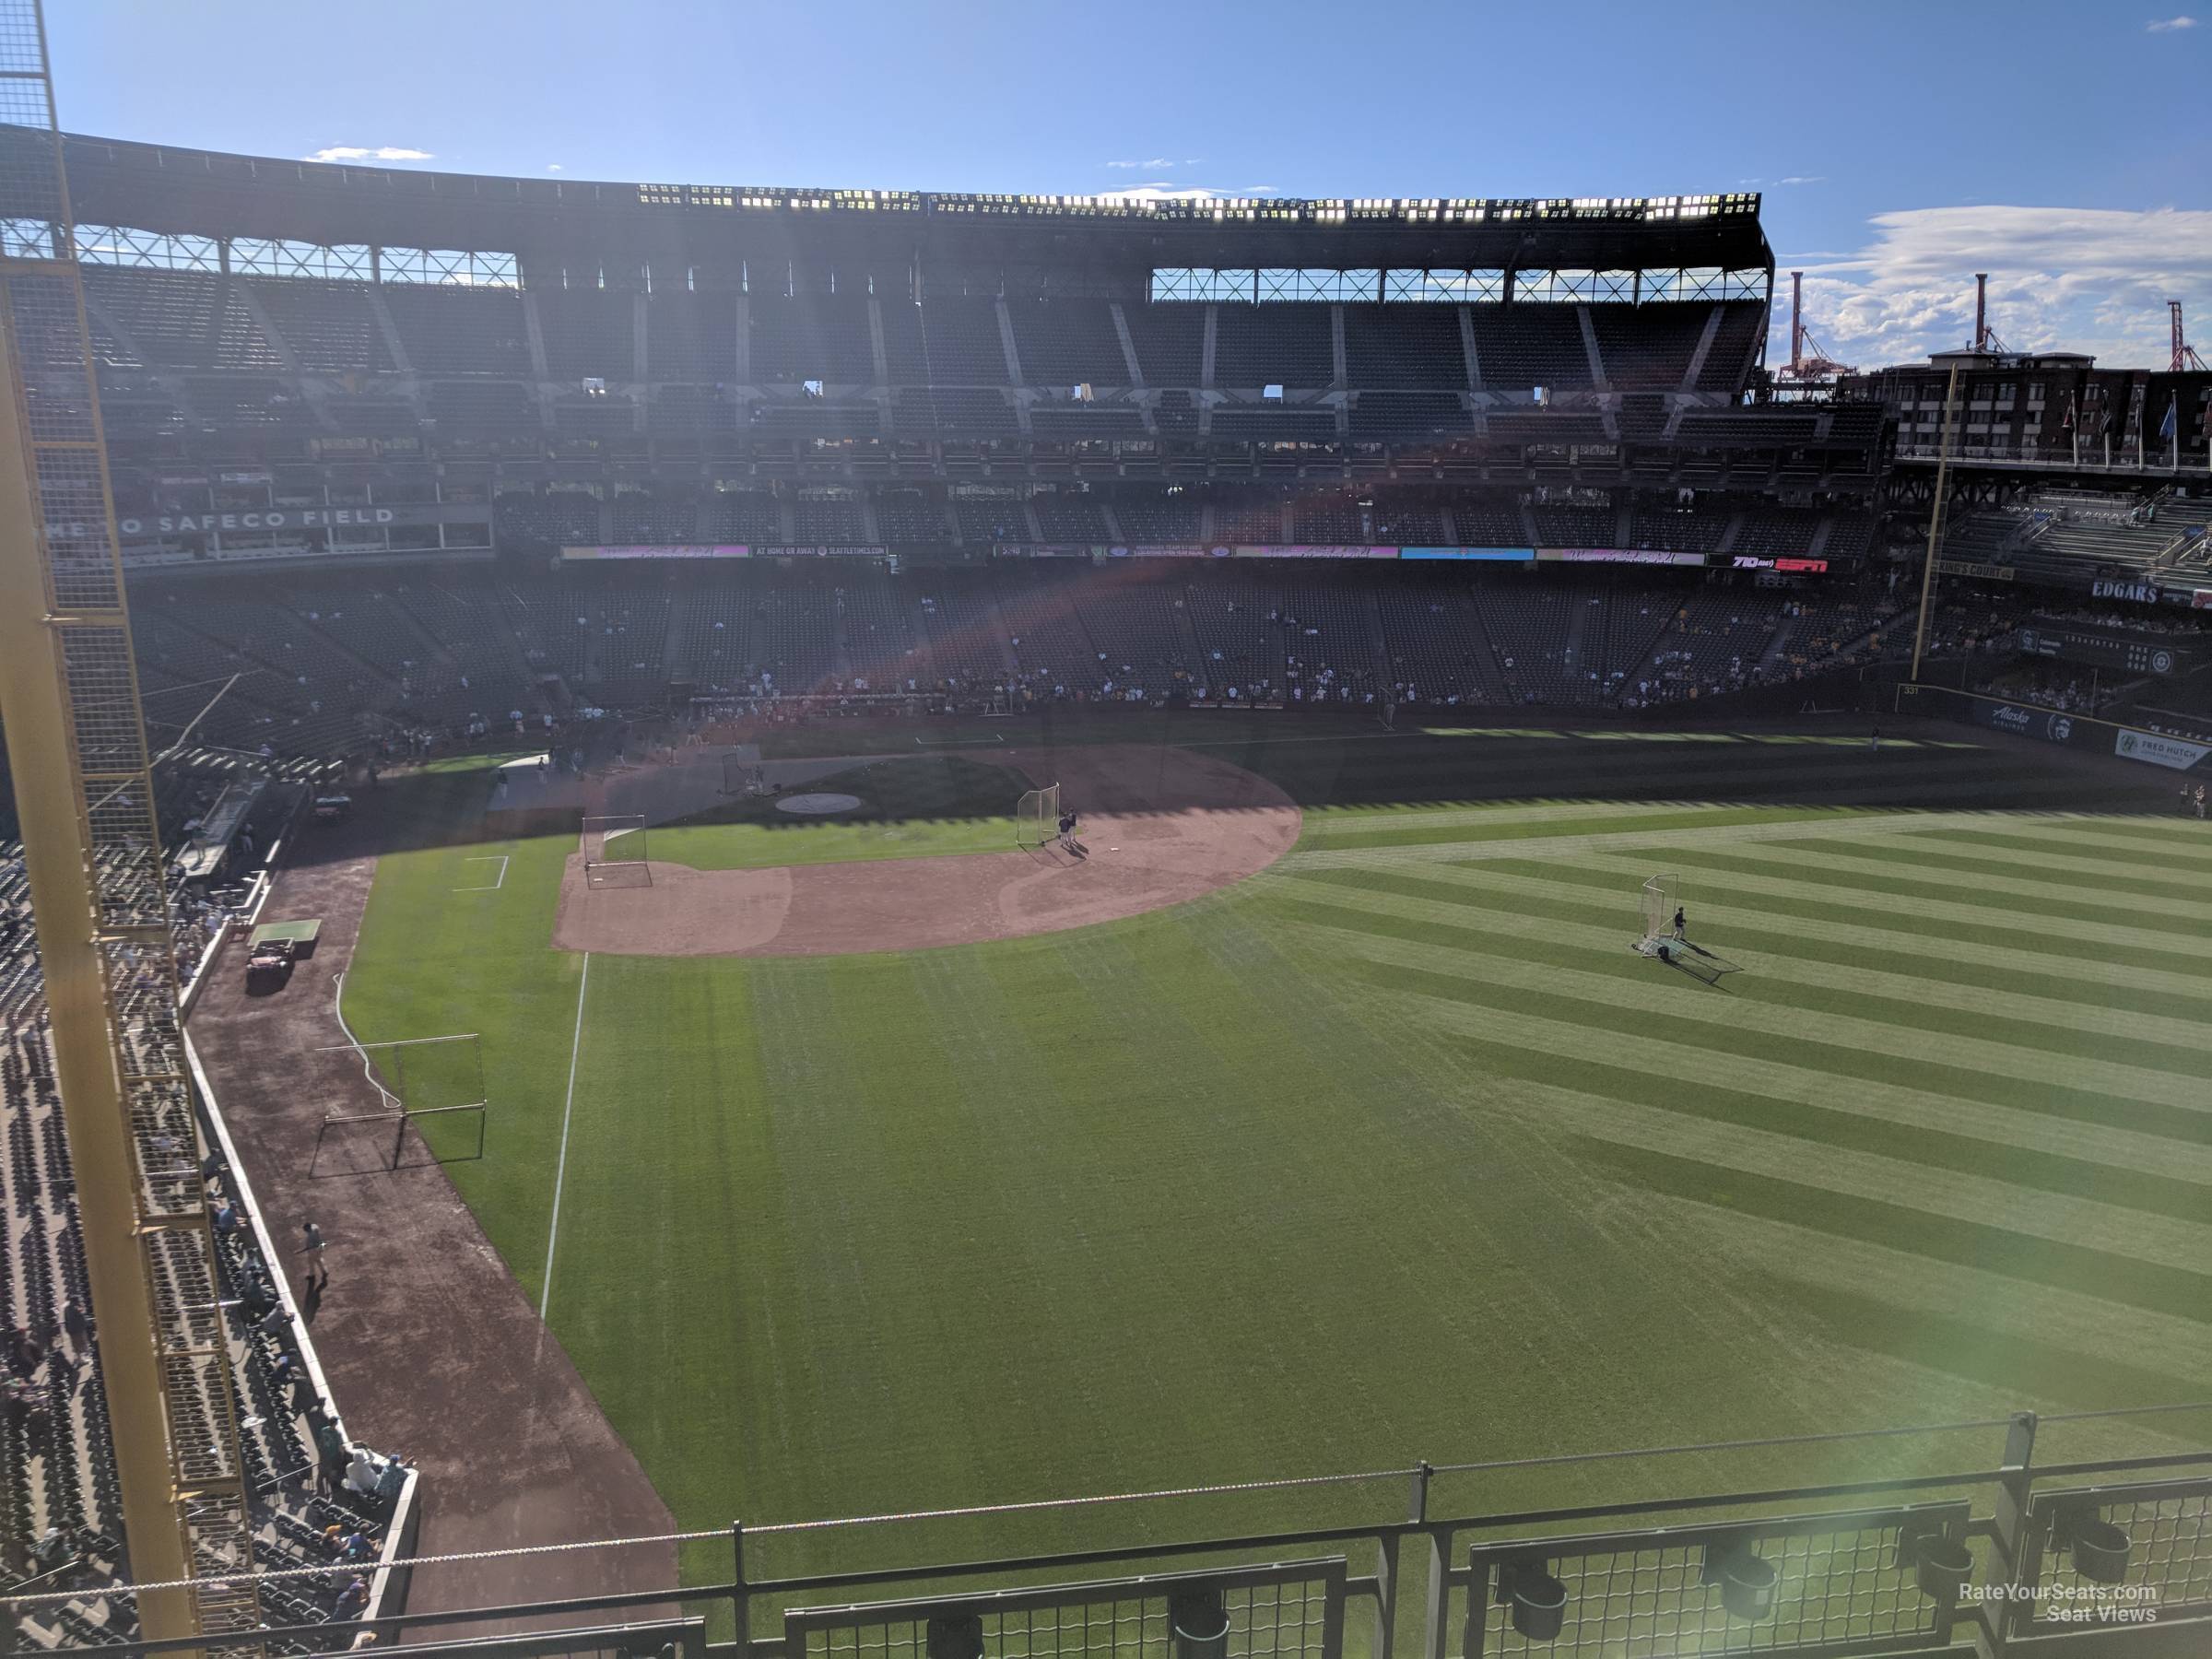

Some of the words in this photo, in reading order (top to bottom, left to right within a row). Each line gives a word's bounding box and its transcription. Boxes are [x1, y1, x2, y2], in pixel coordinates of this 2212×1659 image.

[159, 512, 285, 532] SAFECO
[303, 507, 394, 525] FIELD
[756, 547, 766, 555] AT
[1733, 556, 1759, 568] 710
[1774, 559, 1828, 573] ESPN
[1938, 560, 1969, 574] KING'S
[1970, 564, 2000, 578] COURT
[1903, 686, 1919, 695] 331
[1993, 706, 2030, 724] Alaska
[2141, 740, 2164, 752] FRED
[2166, 746, 2197, 759] HUTCH
